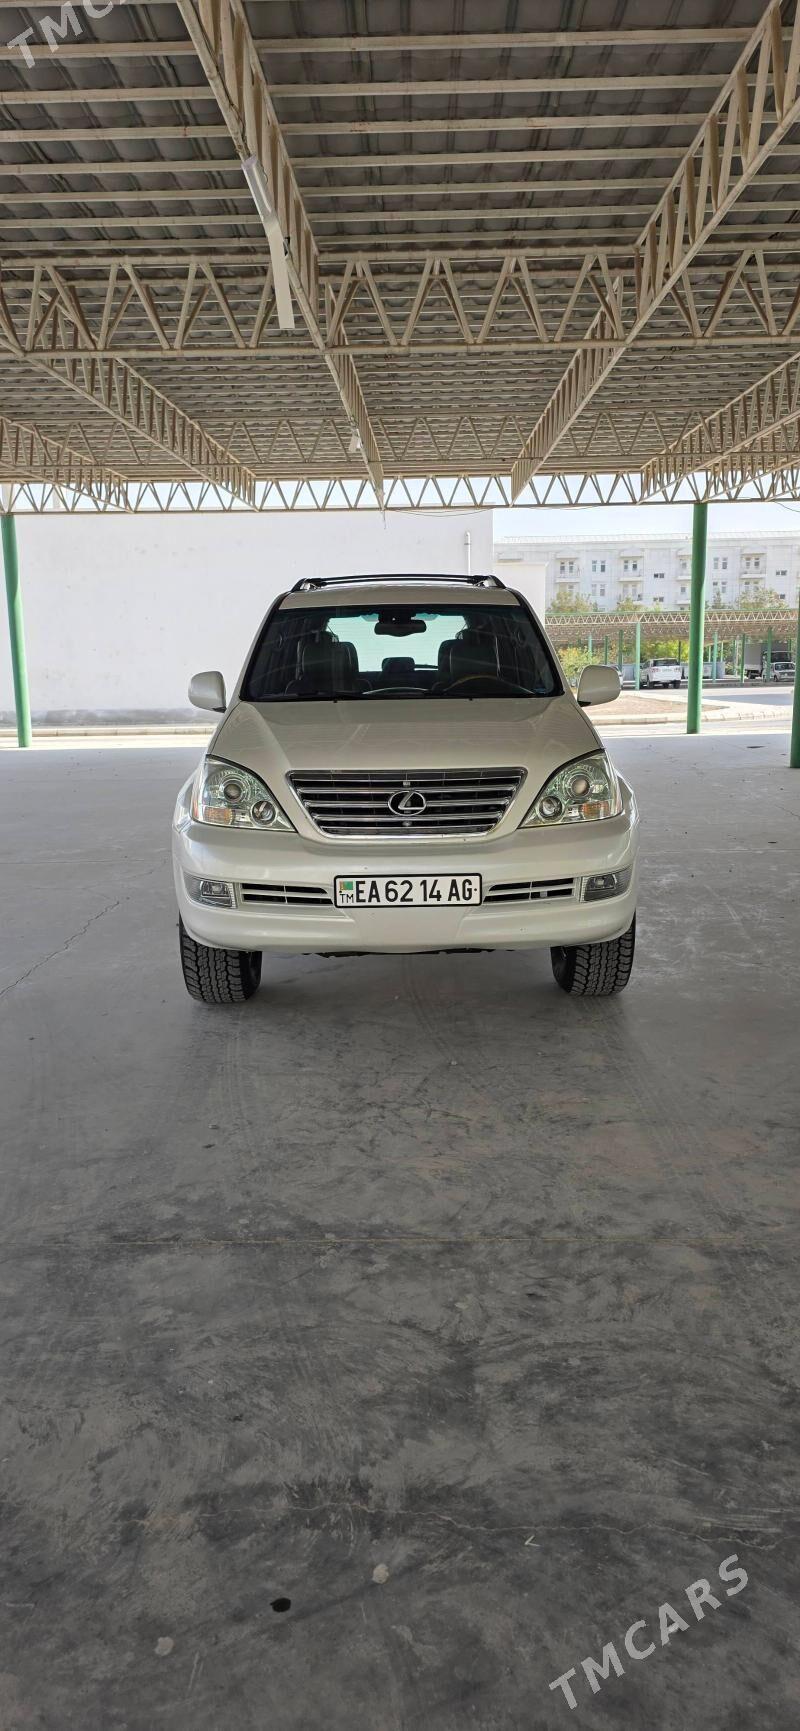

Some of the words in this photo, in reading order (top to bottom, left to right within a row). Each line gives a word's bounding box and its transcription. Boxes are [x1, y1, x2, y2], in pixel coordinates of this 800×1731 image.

[339, 893, 354, 904] TM
[355, 880, 381, 903] EA
[385, 880, 414, 903] 62
[420, 879, 442, 902] 14
[447, 878, 473, 902] AG
